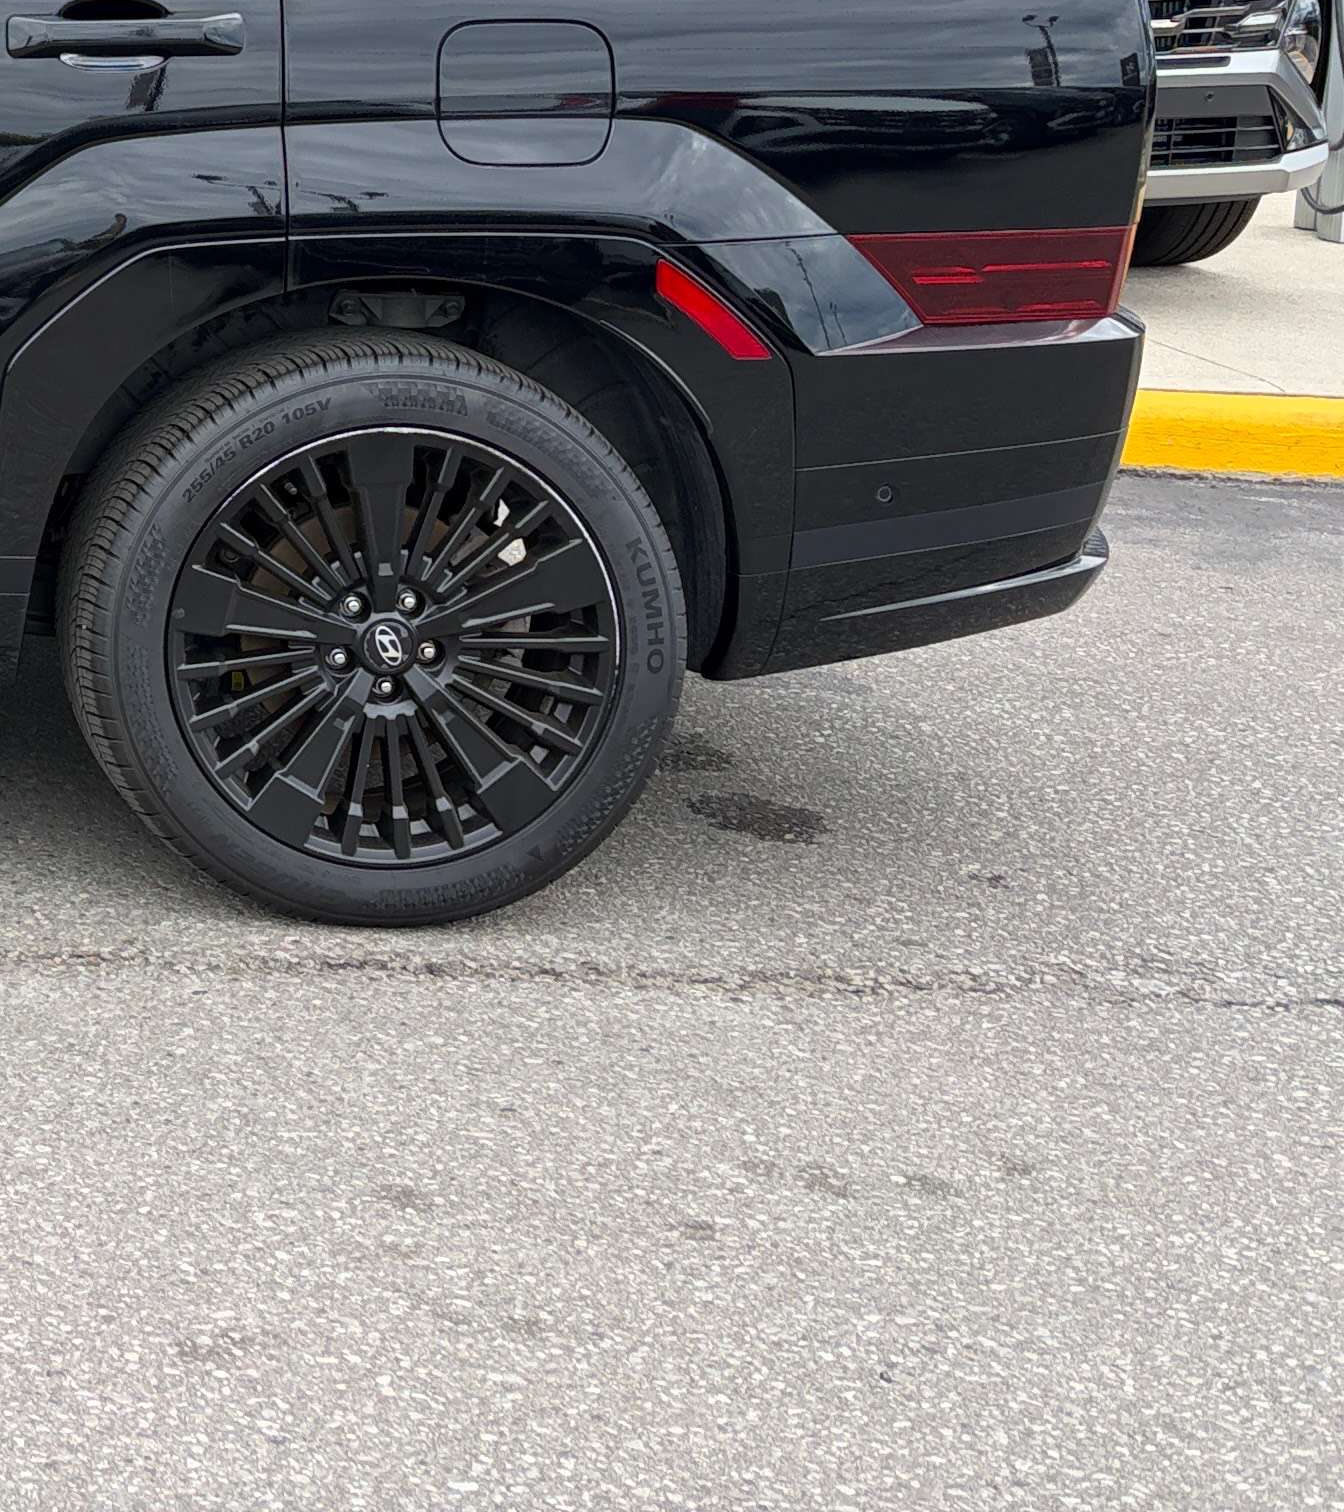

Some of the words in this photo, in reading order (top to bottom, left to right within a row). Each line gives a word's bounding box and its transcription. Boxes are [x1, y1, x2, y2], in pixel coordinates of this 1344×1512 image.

[181, 444, 238, 504] 255/45
[237, 420, 277, 451] R20
[280, 396, 333, 426] 105V
[625, 536, 666, 676] KUMHO
